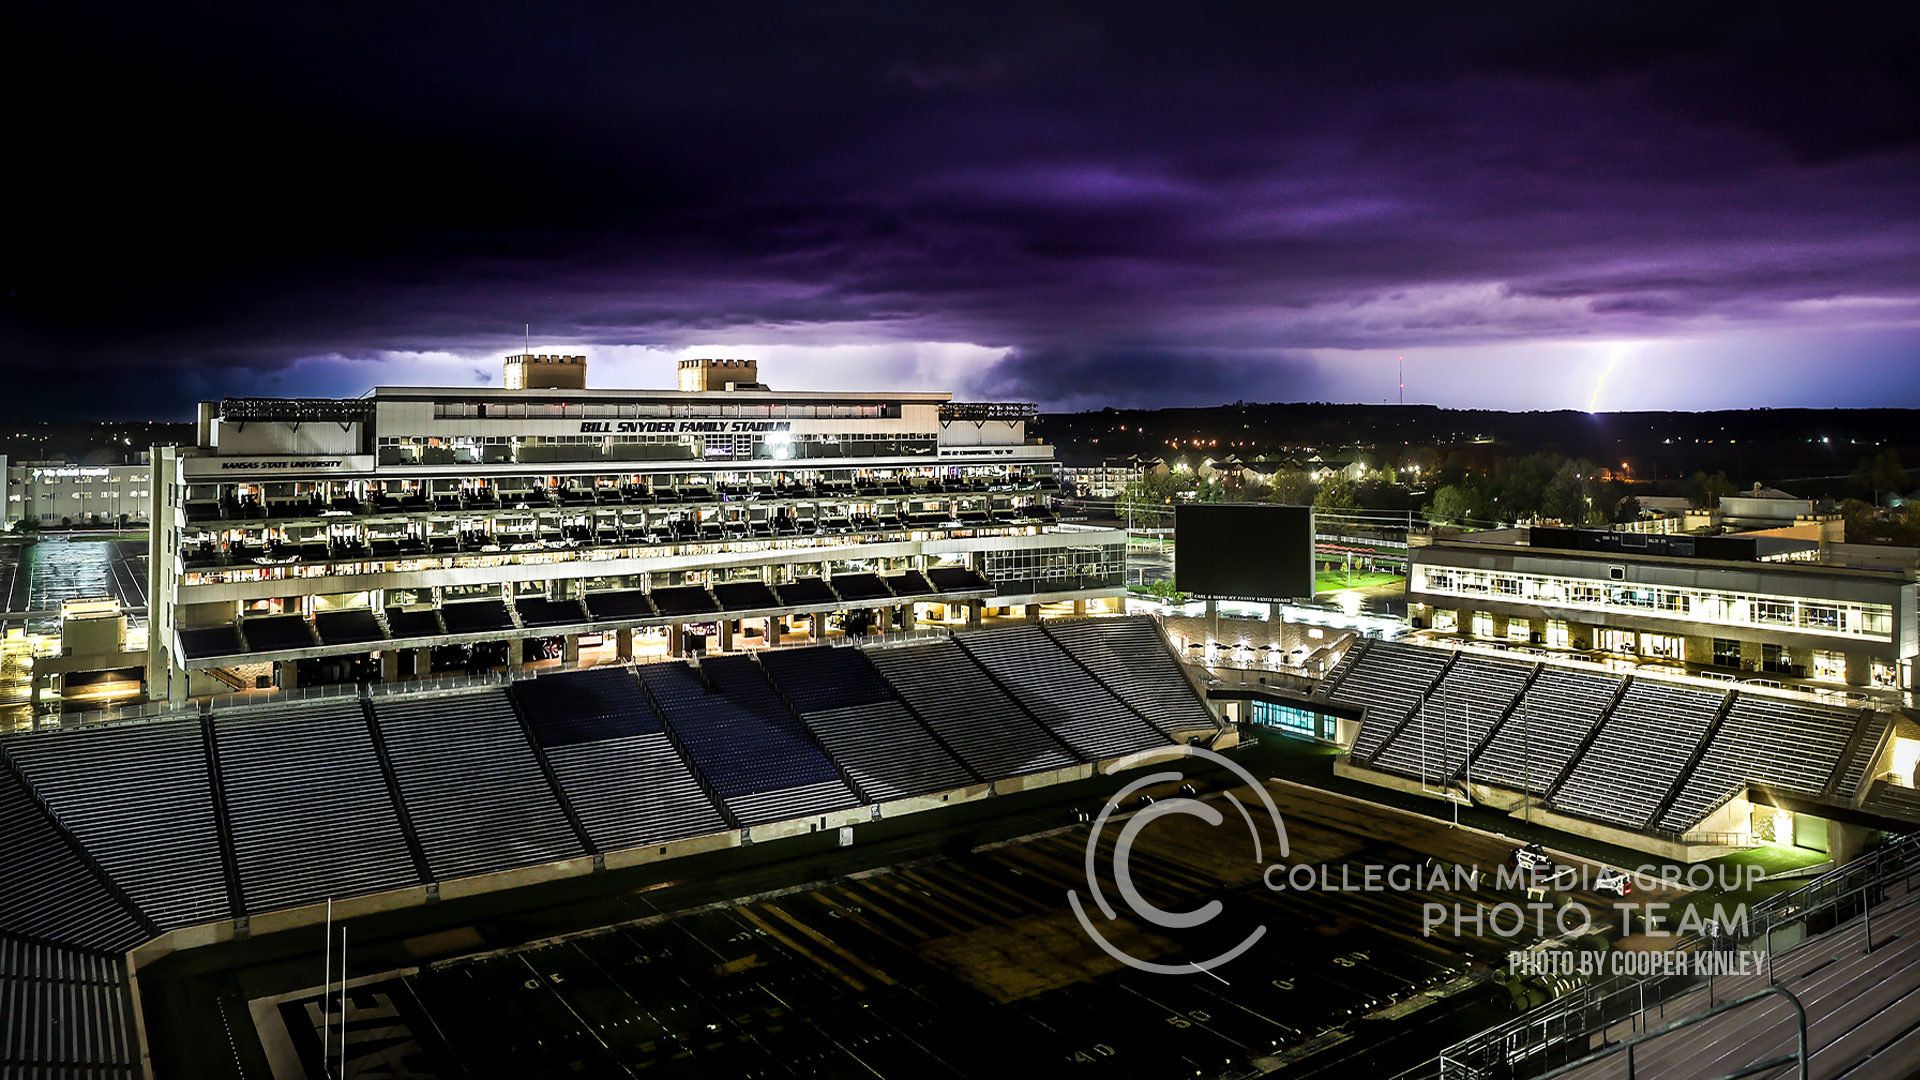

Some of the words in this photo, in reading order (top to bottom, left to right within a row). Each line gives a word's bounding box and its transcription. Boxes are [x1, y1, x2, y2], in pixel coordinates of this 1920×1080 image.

[580, 422, 612, 433] BILL
[617, 422, 676, 433] SNYDER
[679, 422, 728, 432] FAMILY
[731, 421, 791, 432] STADIUM
[222, 461, 259, 470] KANSAS
[261, 461, 289, 469] STATE
[290, 460, 343, 469] UNIVERSITY
[1164, 1010, 1211, 1029] 50
